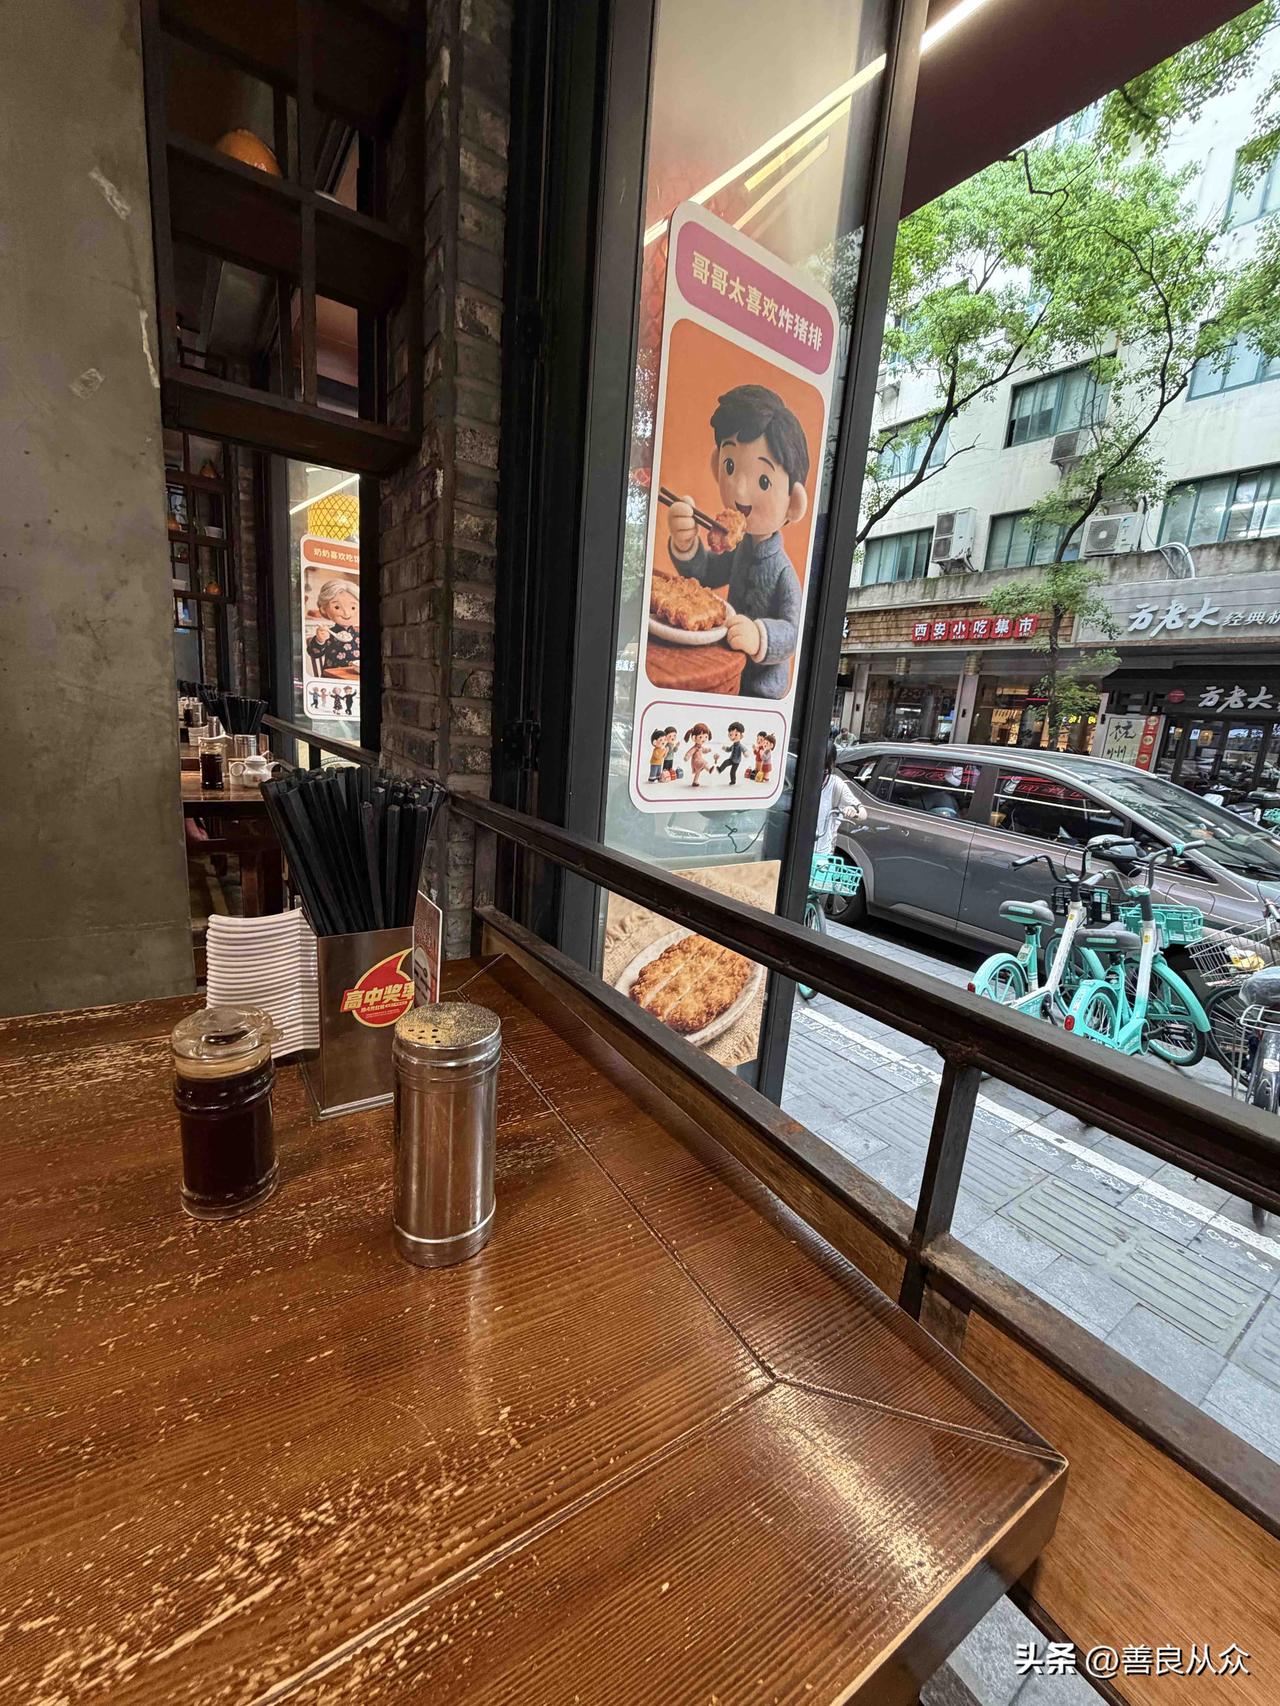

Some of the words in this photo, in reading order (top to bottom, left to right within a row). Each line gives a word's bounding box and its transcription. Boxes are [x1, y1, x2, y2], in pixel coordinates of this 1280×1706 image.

[692, 251, 823, 352] 哥哥太喜欢炸猪排
[915, 618, 1033, 637] 西安小吃集市
